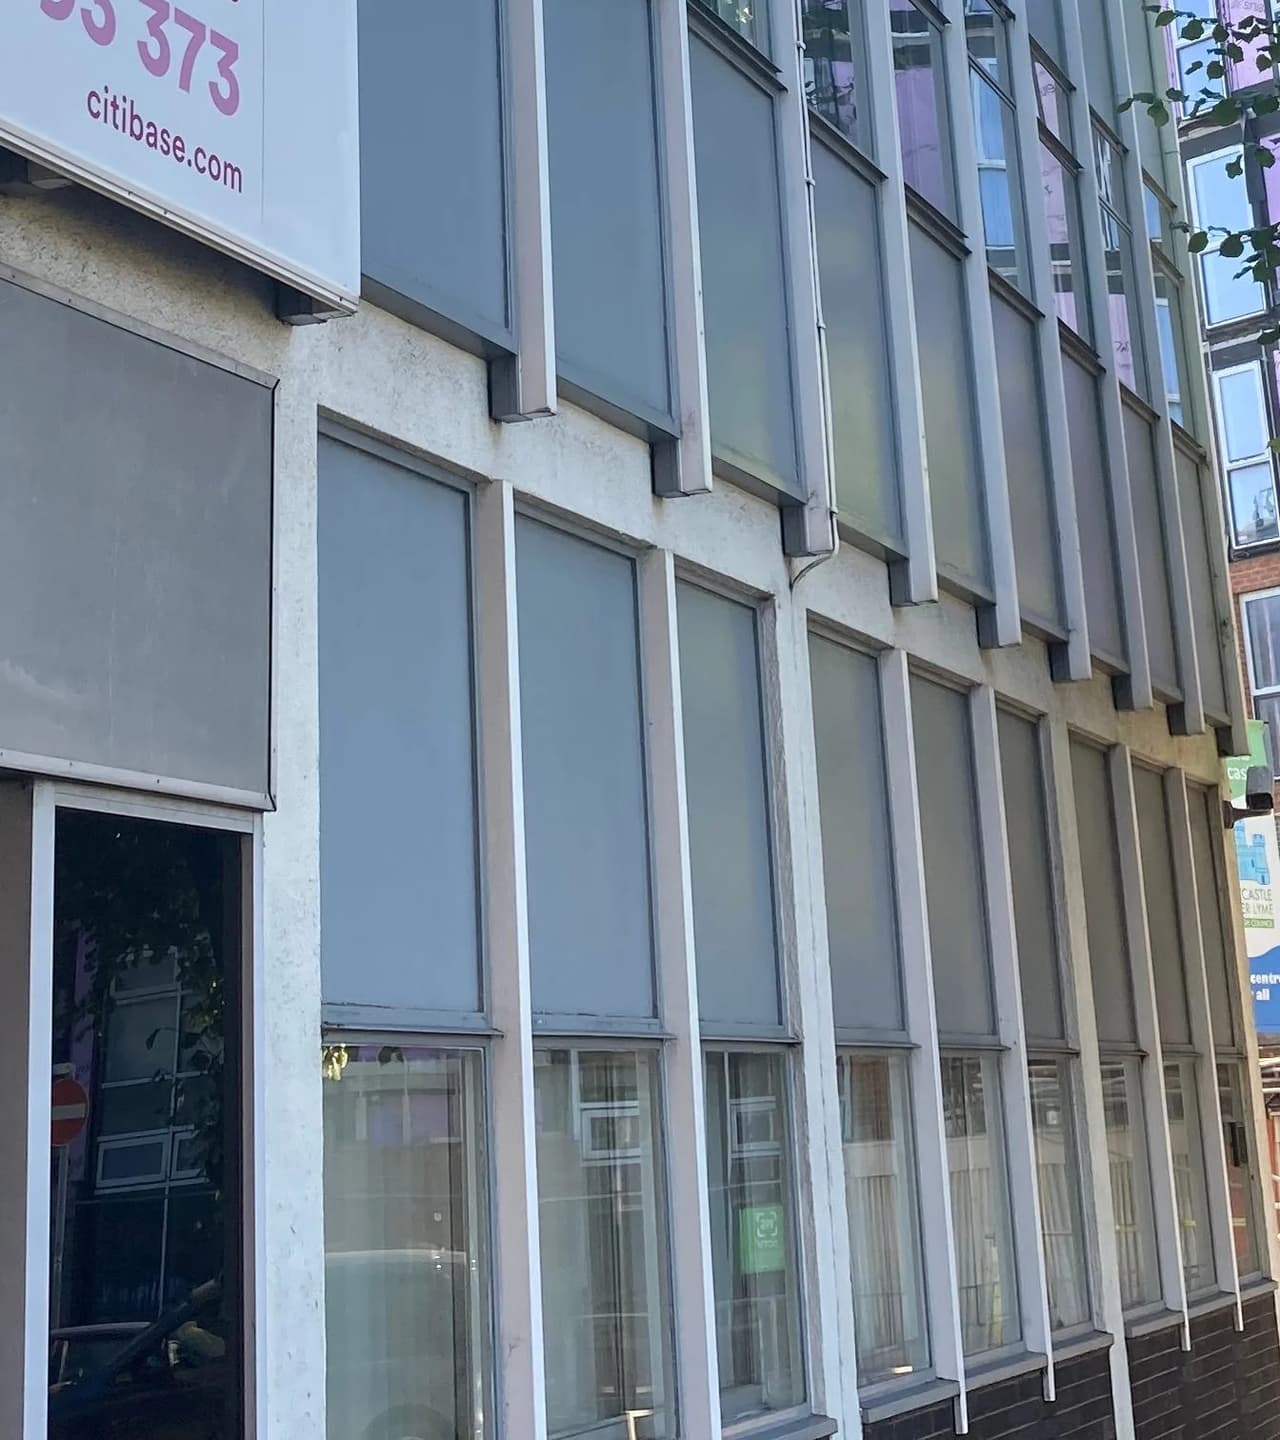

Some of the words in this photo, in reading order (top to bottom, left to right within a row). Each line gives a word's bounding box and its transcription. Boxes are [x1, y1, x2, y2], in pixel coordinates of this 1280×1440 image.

[86, 84, 243, 194] citibase.com
[1241, 888, 1273, 902] CASTLE
[1256, 988, 1270, 1001] all
